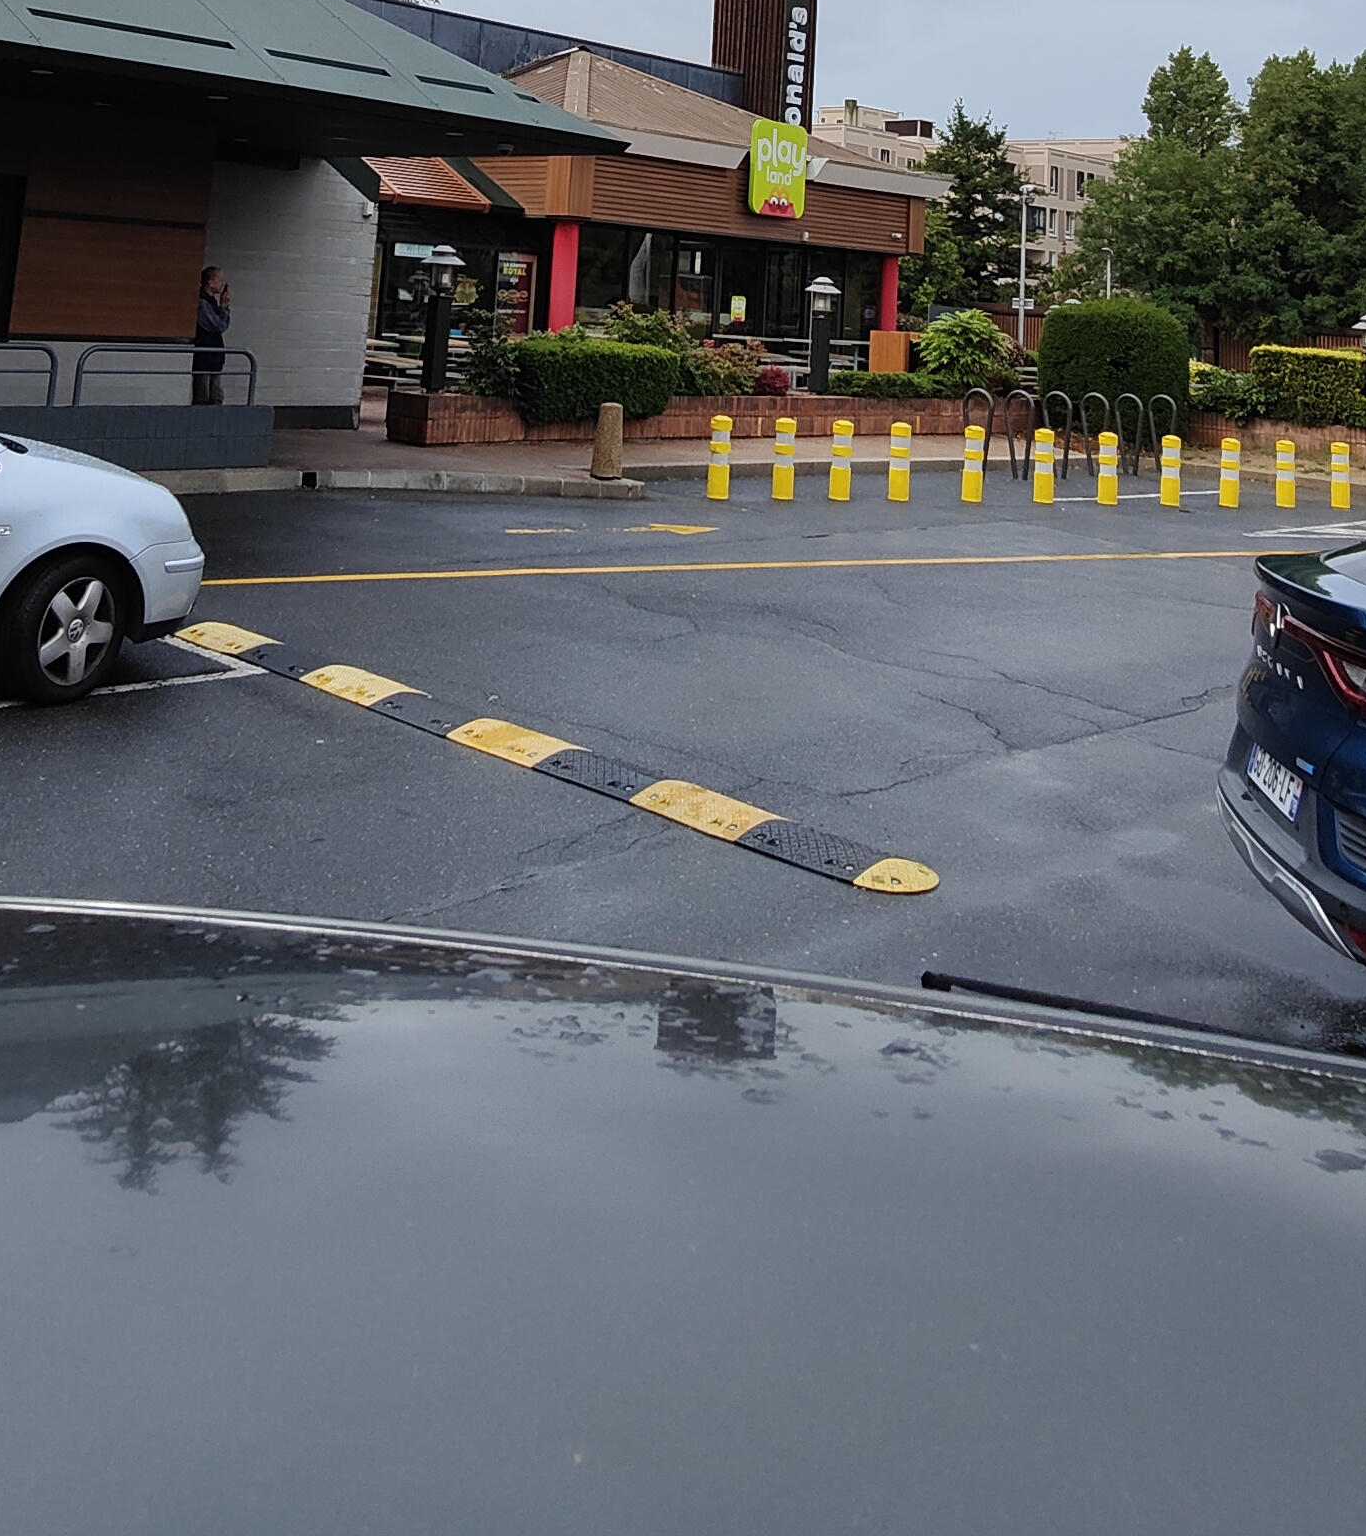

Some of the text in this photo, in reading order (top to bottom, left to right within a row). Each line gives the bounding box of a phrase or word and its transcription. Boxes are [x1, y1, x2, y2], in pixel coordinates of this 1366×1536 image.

[784, 6, 808, 127] onald's
[757, 127, 806, 177] play
[766, 165, 792, 186] land
